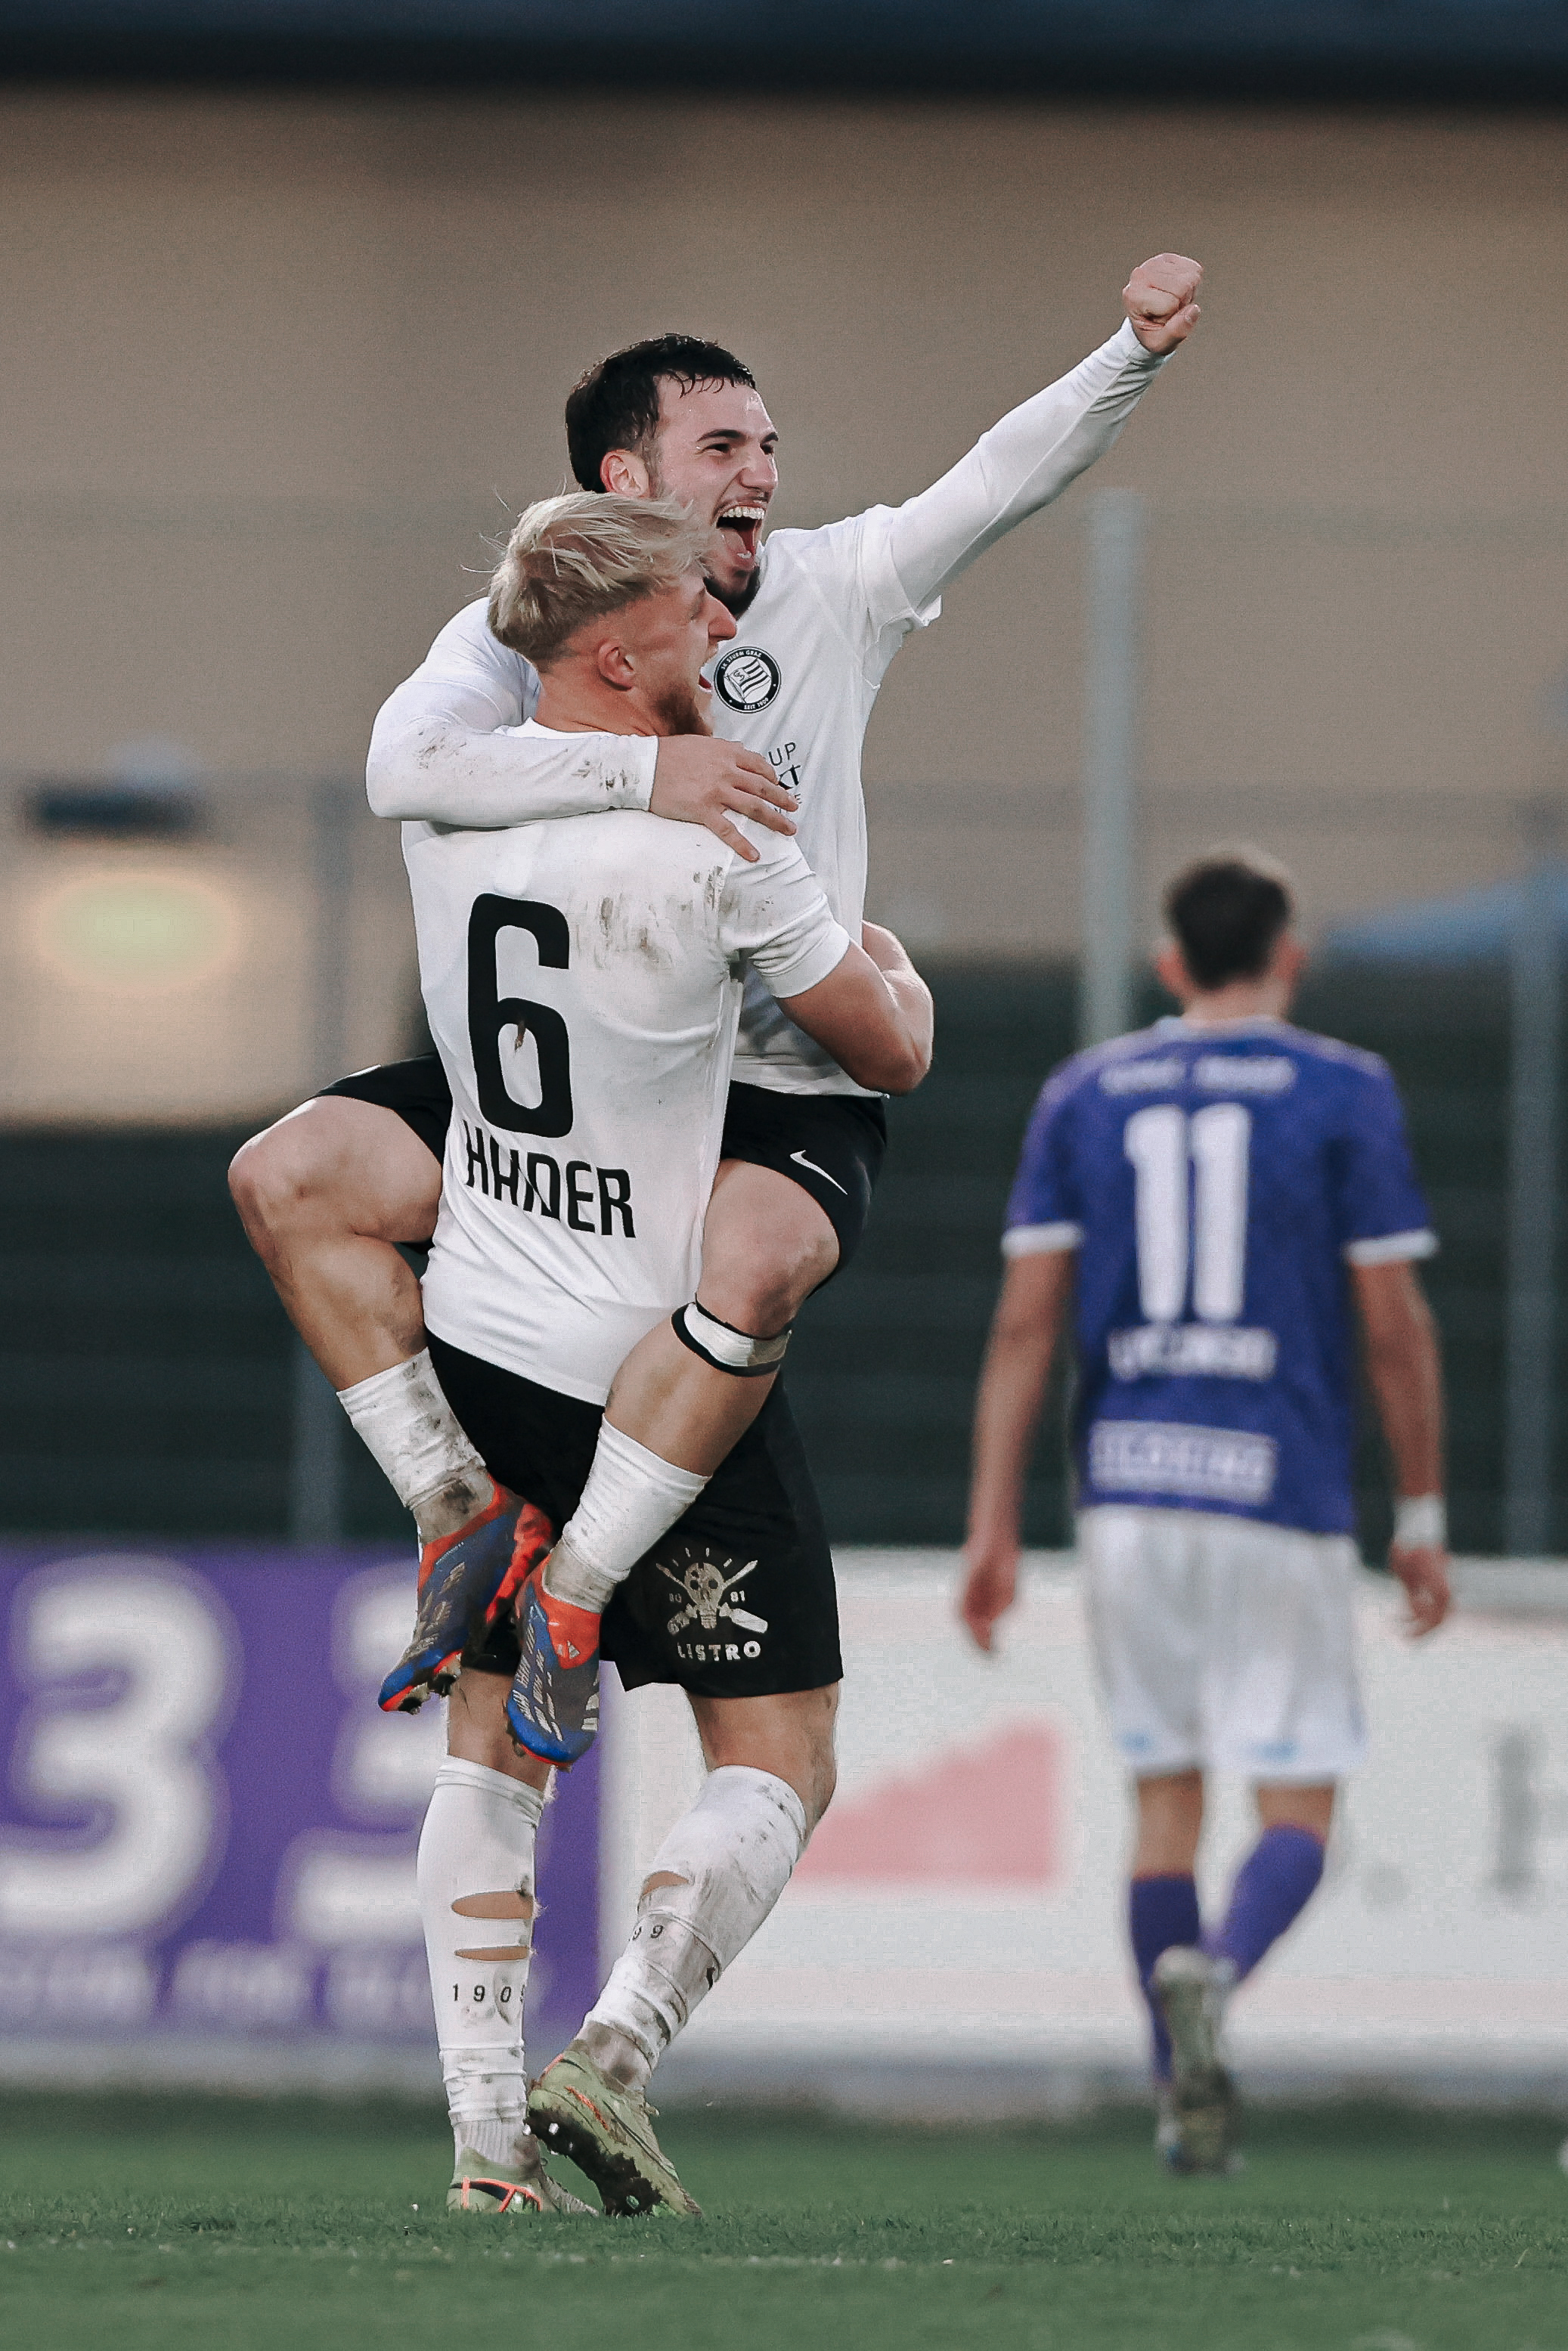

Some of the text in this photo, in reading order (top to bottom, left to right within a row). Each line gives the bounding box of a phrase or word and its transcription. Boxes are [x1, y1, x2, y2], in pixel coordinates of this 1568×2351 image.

[467, 893, 574, 1138] 6
[1123, 1101, 1252, 1324] 11
[677, 1640, 761, 1662] LISTRO
